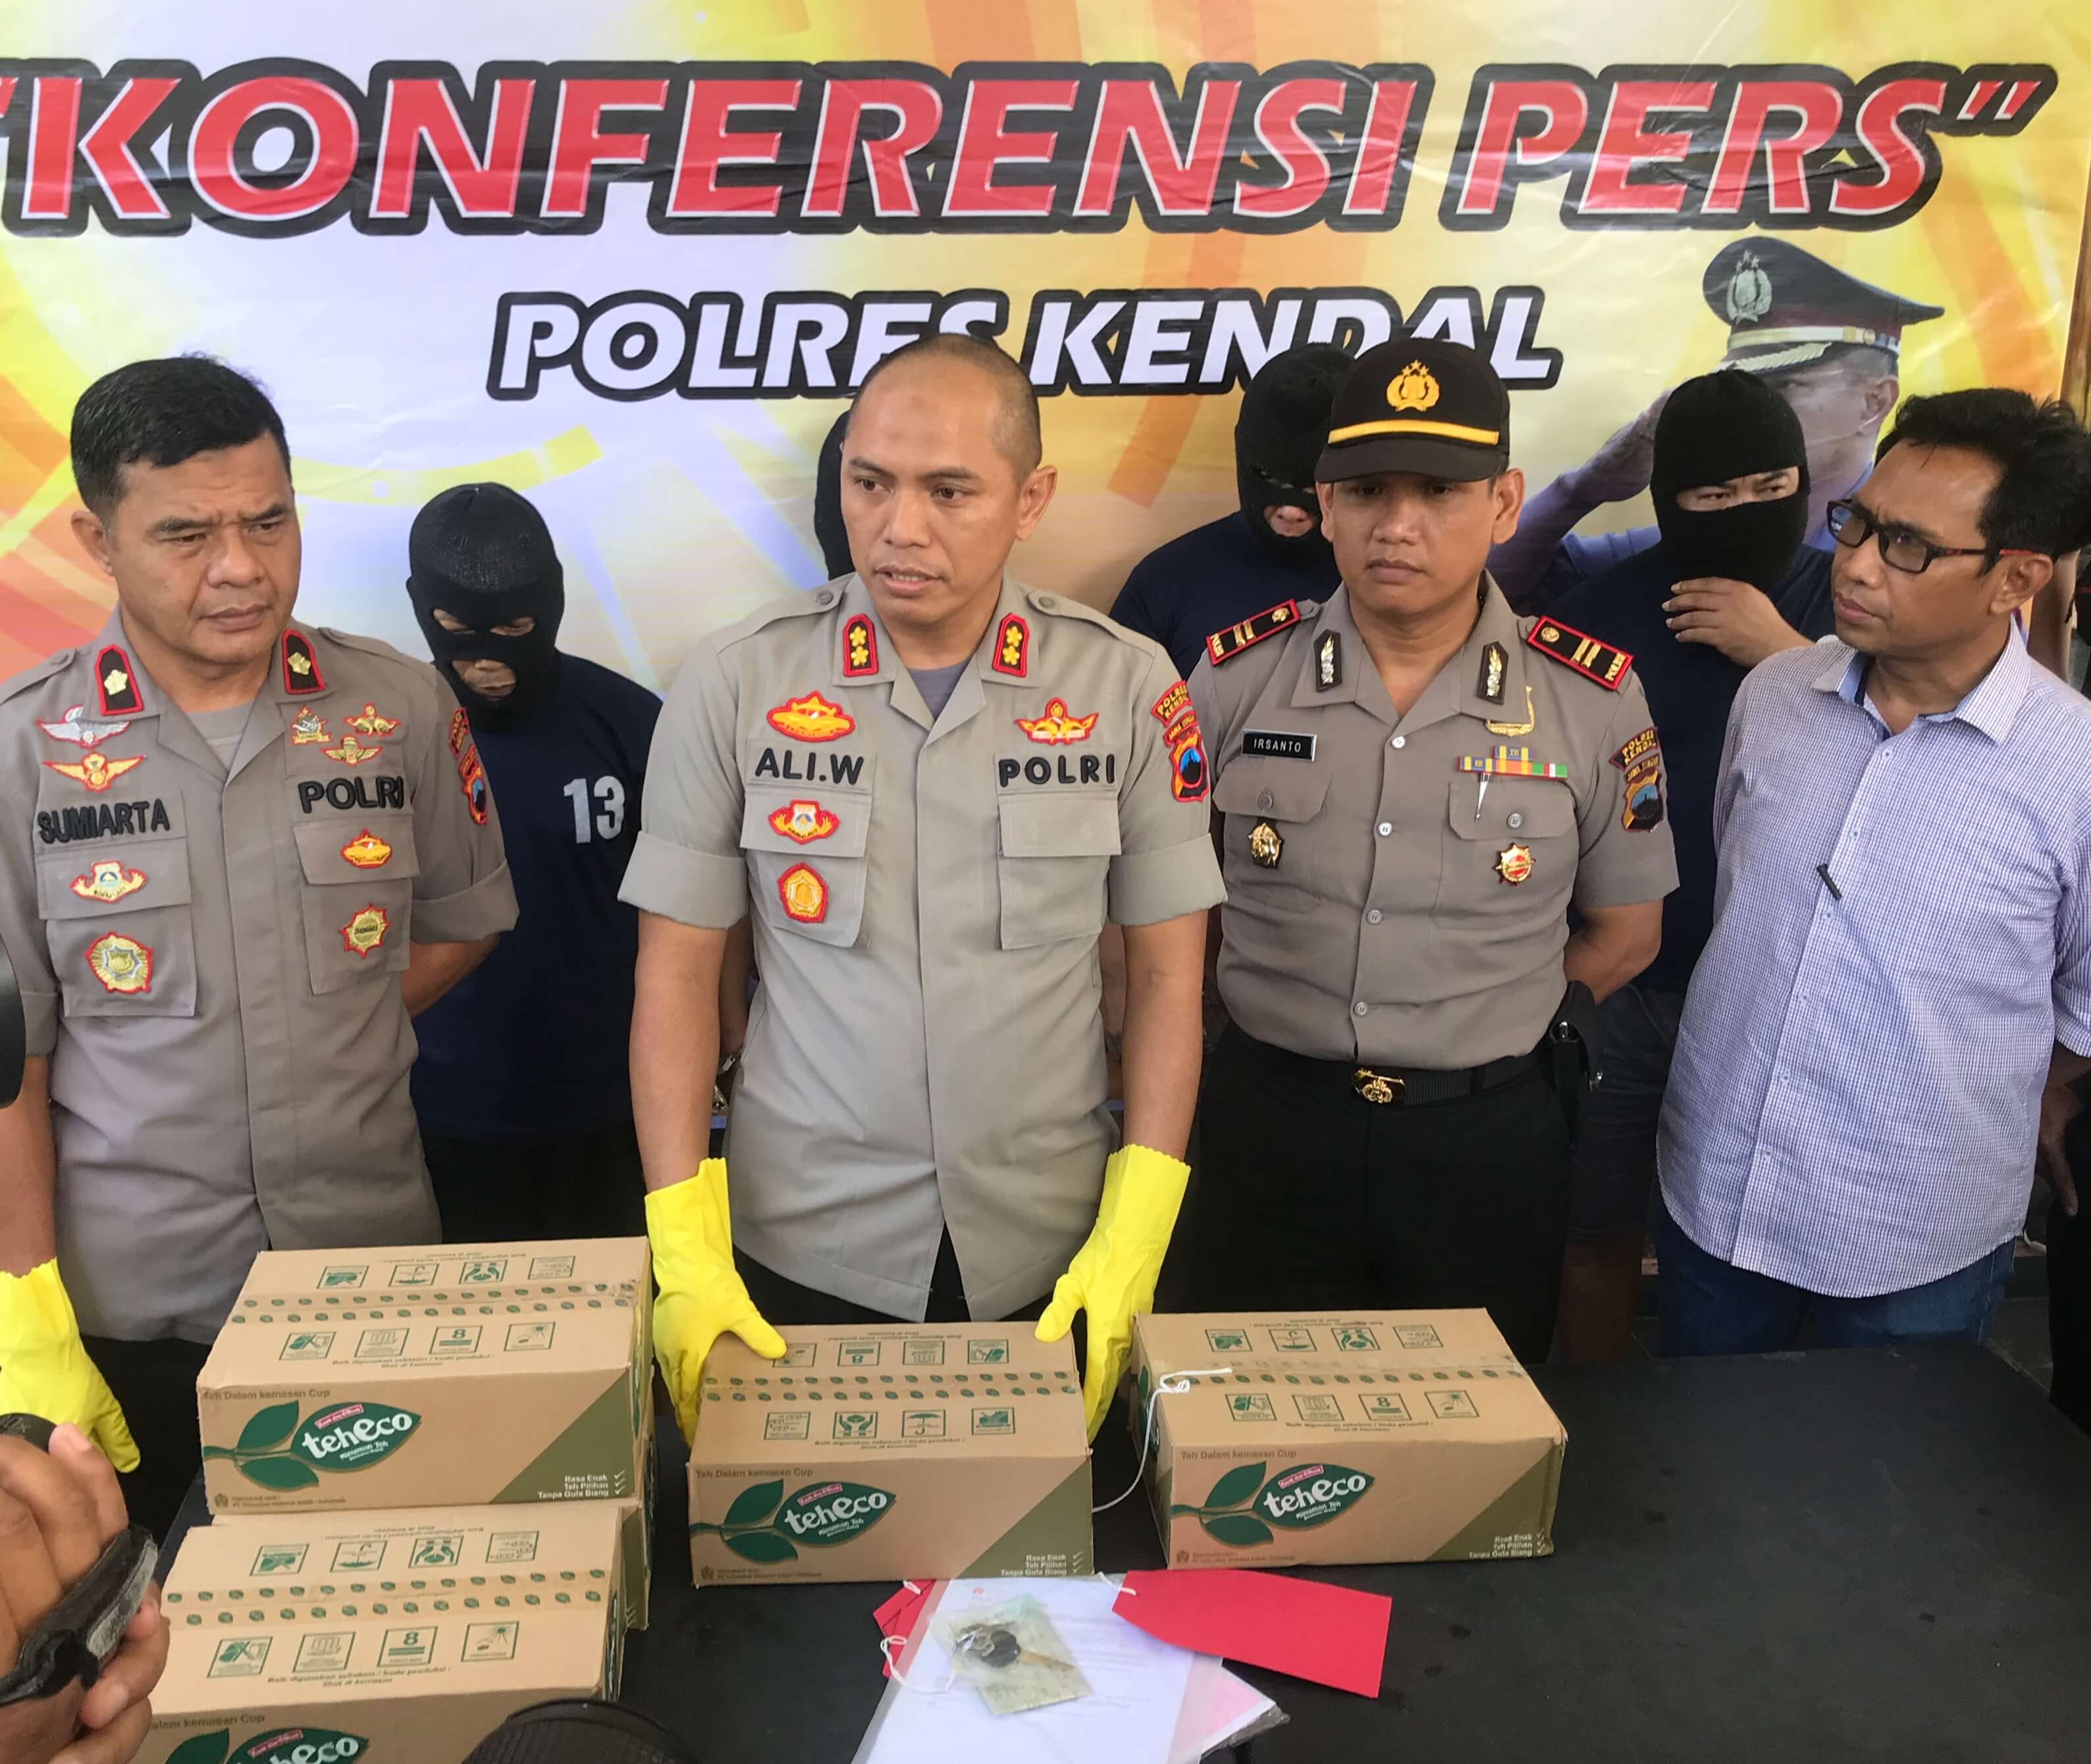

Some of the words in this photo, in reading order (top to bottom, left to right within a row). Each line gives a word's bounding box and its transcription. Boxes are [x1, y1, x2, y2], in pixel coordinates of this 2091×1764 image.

[1254, 738, 1301, 752] IRSANTO
[754, 747, 864, 785] ALI.W
[998, 752, 1116, 787] POLRI
[298, 775, 405, 814] POLRI
[564, 775, 625, 844] 13
[38, 798, 171, 844] SUMIARTA
[452, 1328, 466, 1339] 8
[224, 1391, 257, 1400] Dalam
[259, 1389, 306, 1399] kemasan
[309, 1388, 331, 1398] Cup
[1377, 1395, 1390, 1407] 8
[1181, 1450, 1198, 1460] Teh
[1200, 1450, 1231, 1460] Dalam
[1232, 1449, 1275, 1459] kemasan
[1277, 1449, 1297, 1459] Cup
[696, 1469, 713, 1479] Teh
[716, 1468, 746, 1478] Dalam
[748, 1468, 791, 1477] kemasan
[794, 1468, 813, 1476] Cup
[403, 1631, 419, 1646] 8
[152, 1719, 181, 1729] alam
[240, 1713, 265, 1725] Cup
